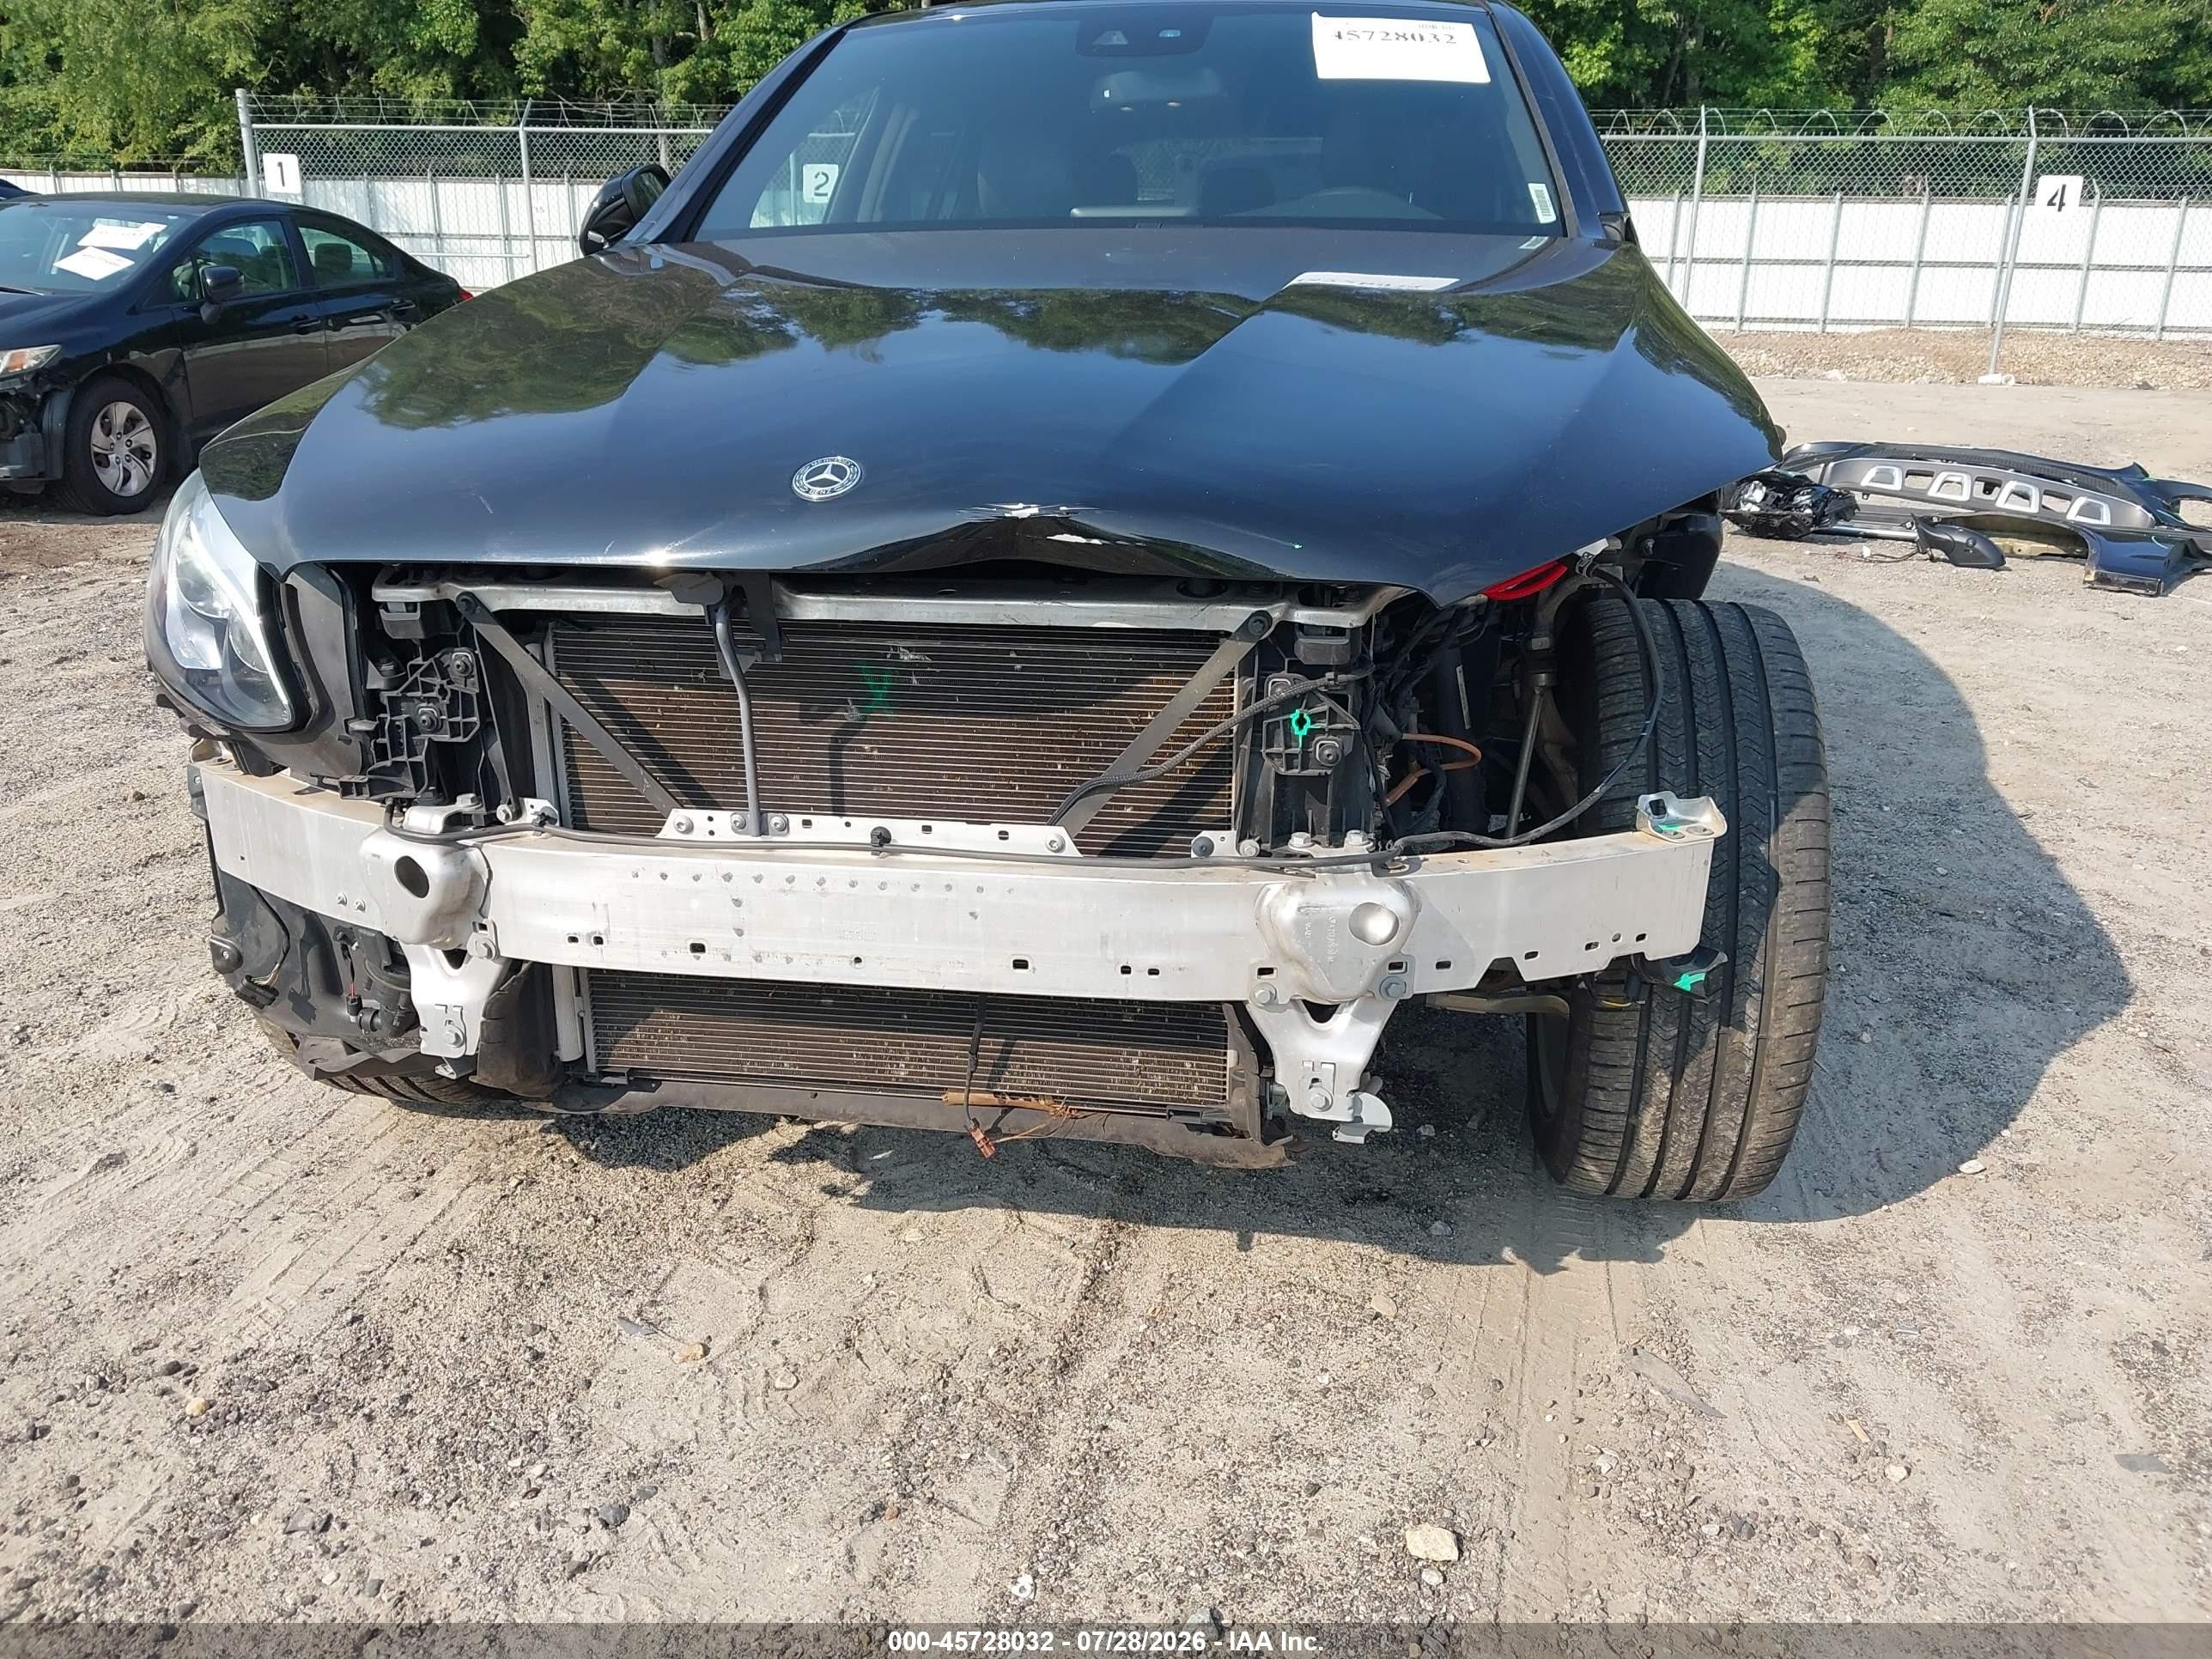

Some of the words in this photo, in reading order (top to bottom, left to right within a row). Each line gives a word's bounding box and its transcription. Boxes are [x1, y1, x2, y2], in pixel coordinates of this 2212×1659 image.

[1334, 29, 1456, 44] 45728032
[277, 161, 285, 187] 1
[814, 172, 829, 197] 2
[2046, 184, 2067, 212] 4
